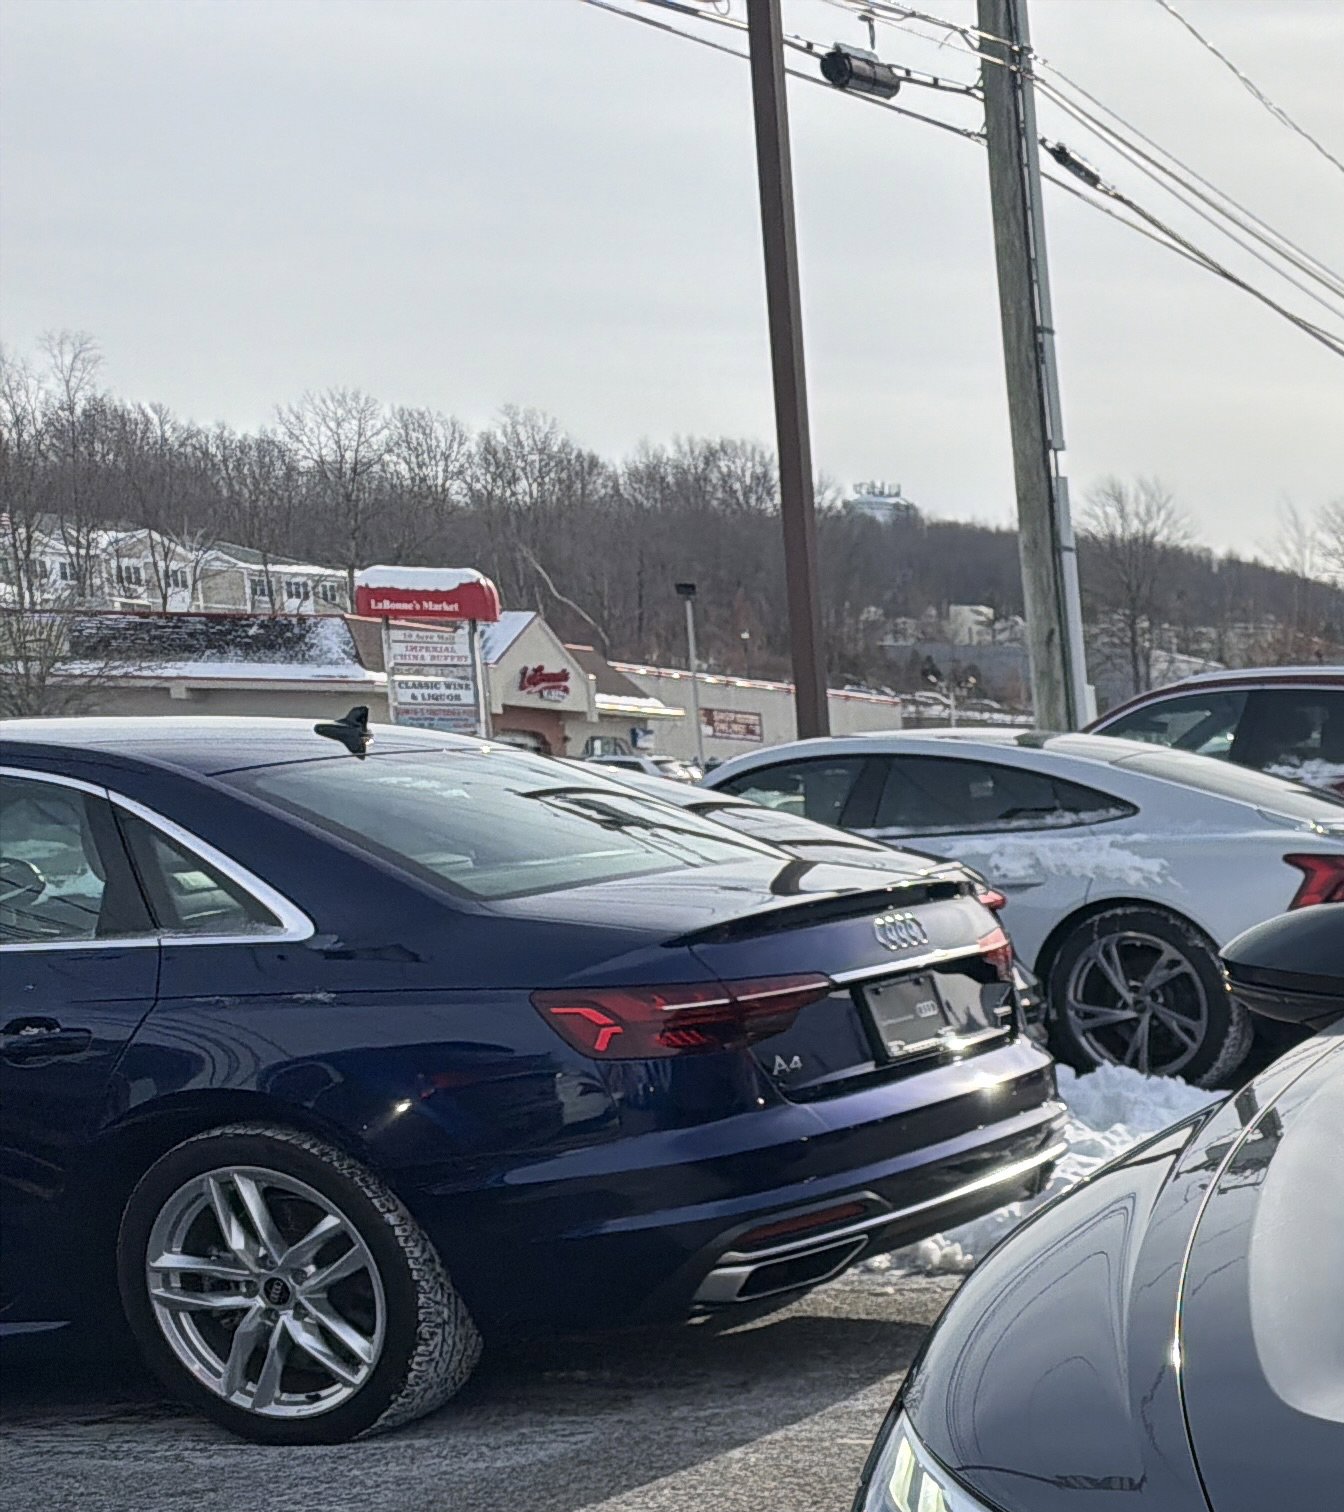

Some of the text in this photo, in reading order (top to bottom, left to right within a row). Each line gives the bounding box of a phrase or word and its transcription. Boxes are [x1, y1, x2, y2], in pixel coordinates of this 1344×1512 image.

[370, 598, 459, 612] LaBonne's Market
[398, 681, 471, 691] CLASSIC WINE
[421, 692, 462, 702] LIQUOR
[772, 1054, 803, 1076] A4
